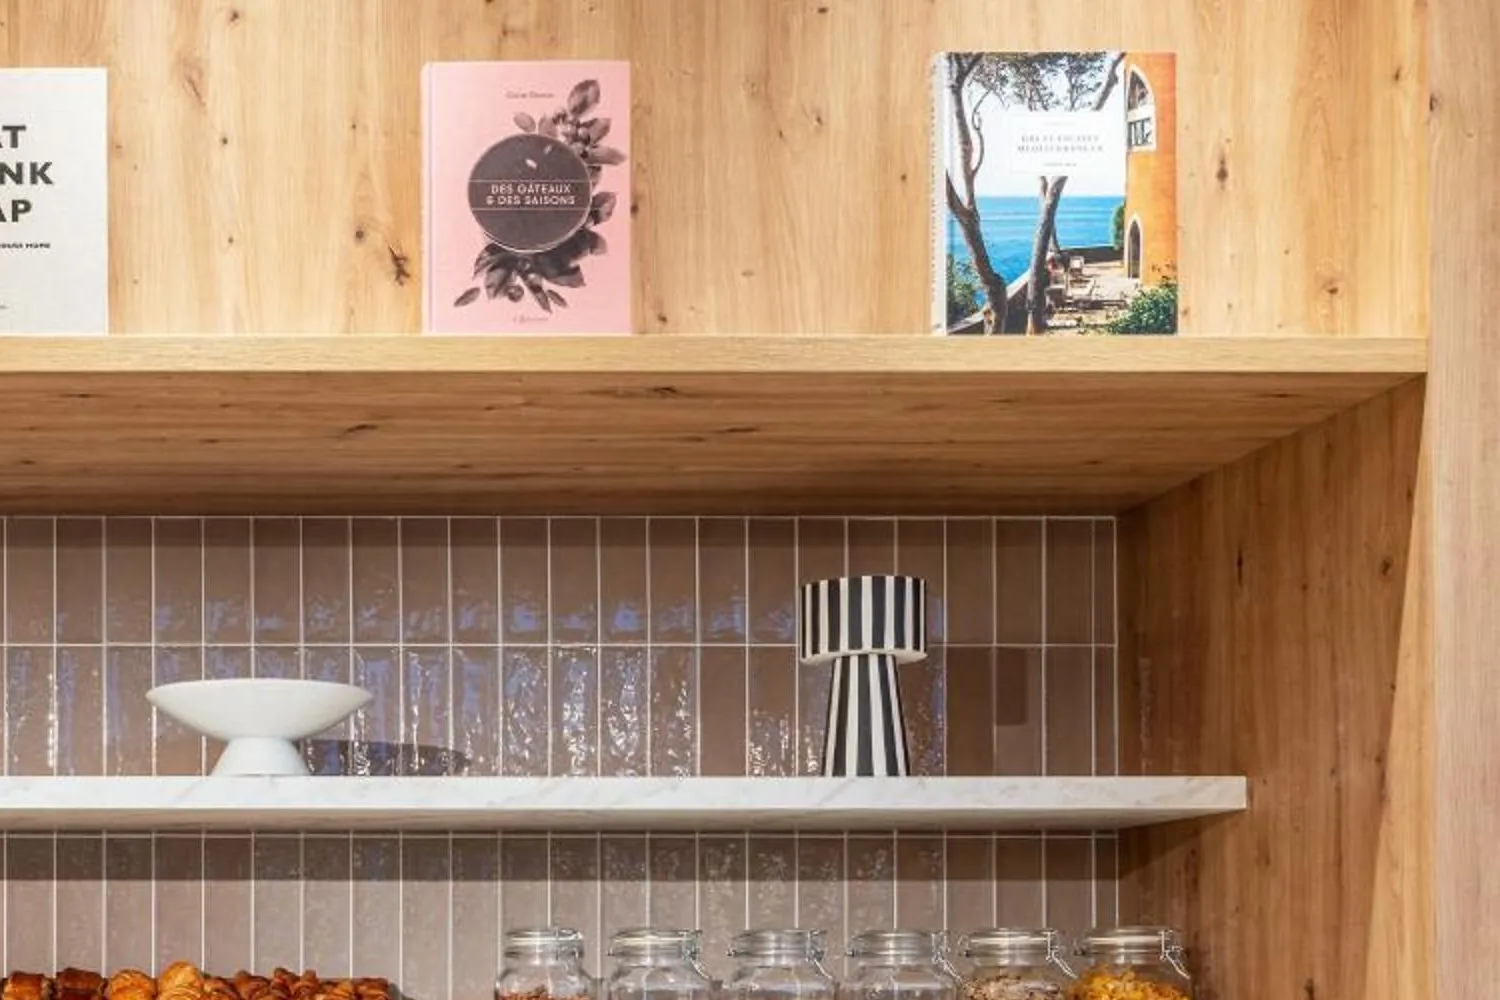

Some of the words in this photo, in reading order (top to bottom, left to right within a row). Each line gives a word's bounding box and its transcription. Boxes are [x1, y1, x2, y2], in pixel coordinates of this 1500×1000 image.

[491, 183, 513, 195] DES
[498, 195, 520, 205] DES
[524, 195, 575, 205] SAISONS
